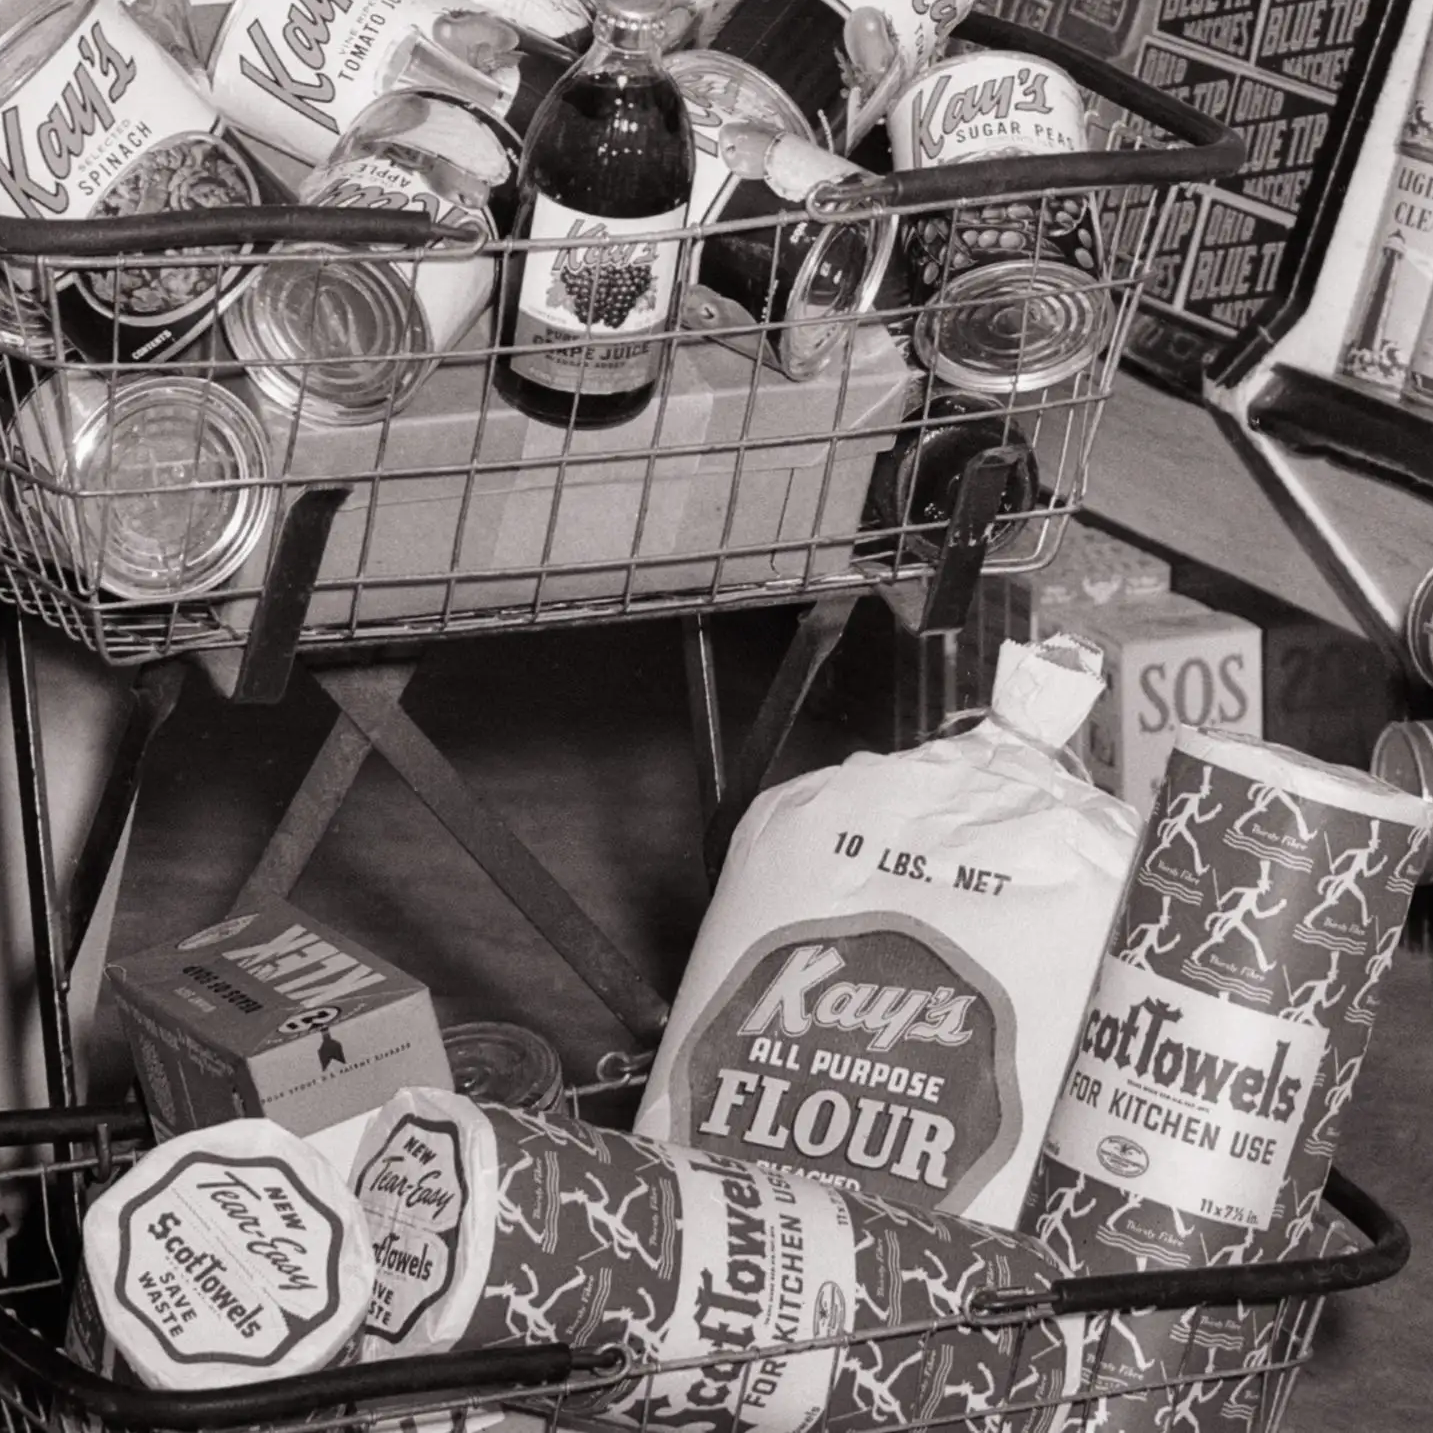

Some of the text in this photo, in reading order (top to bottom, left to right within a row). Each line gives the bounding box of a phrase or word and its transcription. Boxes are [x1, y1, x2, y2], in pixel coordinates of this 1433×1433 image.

[337, 13, 386, 82] TOMATO
[911, 64, 1053, 154] Kay's
[957, 124, 1075, 150] SUGAR PEA
[78, 119, 154, 196] SPINACH
[1139, 656, 1250, 733] S.O.S
[833, 832, 1011, 897] 10 LBS. NET
[739, 946, 976, 1052] Kay's
[749, 1038, 944, 1103] ALL PURPOSE
[1083, 999, 1303, 1122] cotTowels
[700, 1067, 956, 1189] FLOUR
[1069, 1073, 1275, 1164] FOR KITCHEN USE
[198, 1176, 316, 1295] Tear-Easy
[264, 1185, 305, 1234] NEW
[138, 1272, 185, 1339] WASTE
[148, 1213, 263, 1339] ScotTowels
[160, 1271, 200, 1322] SAVE
